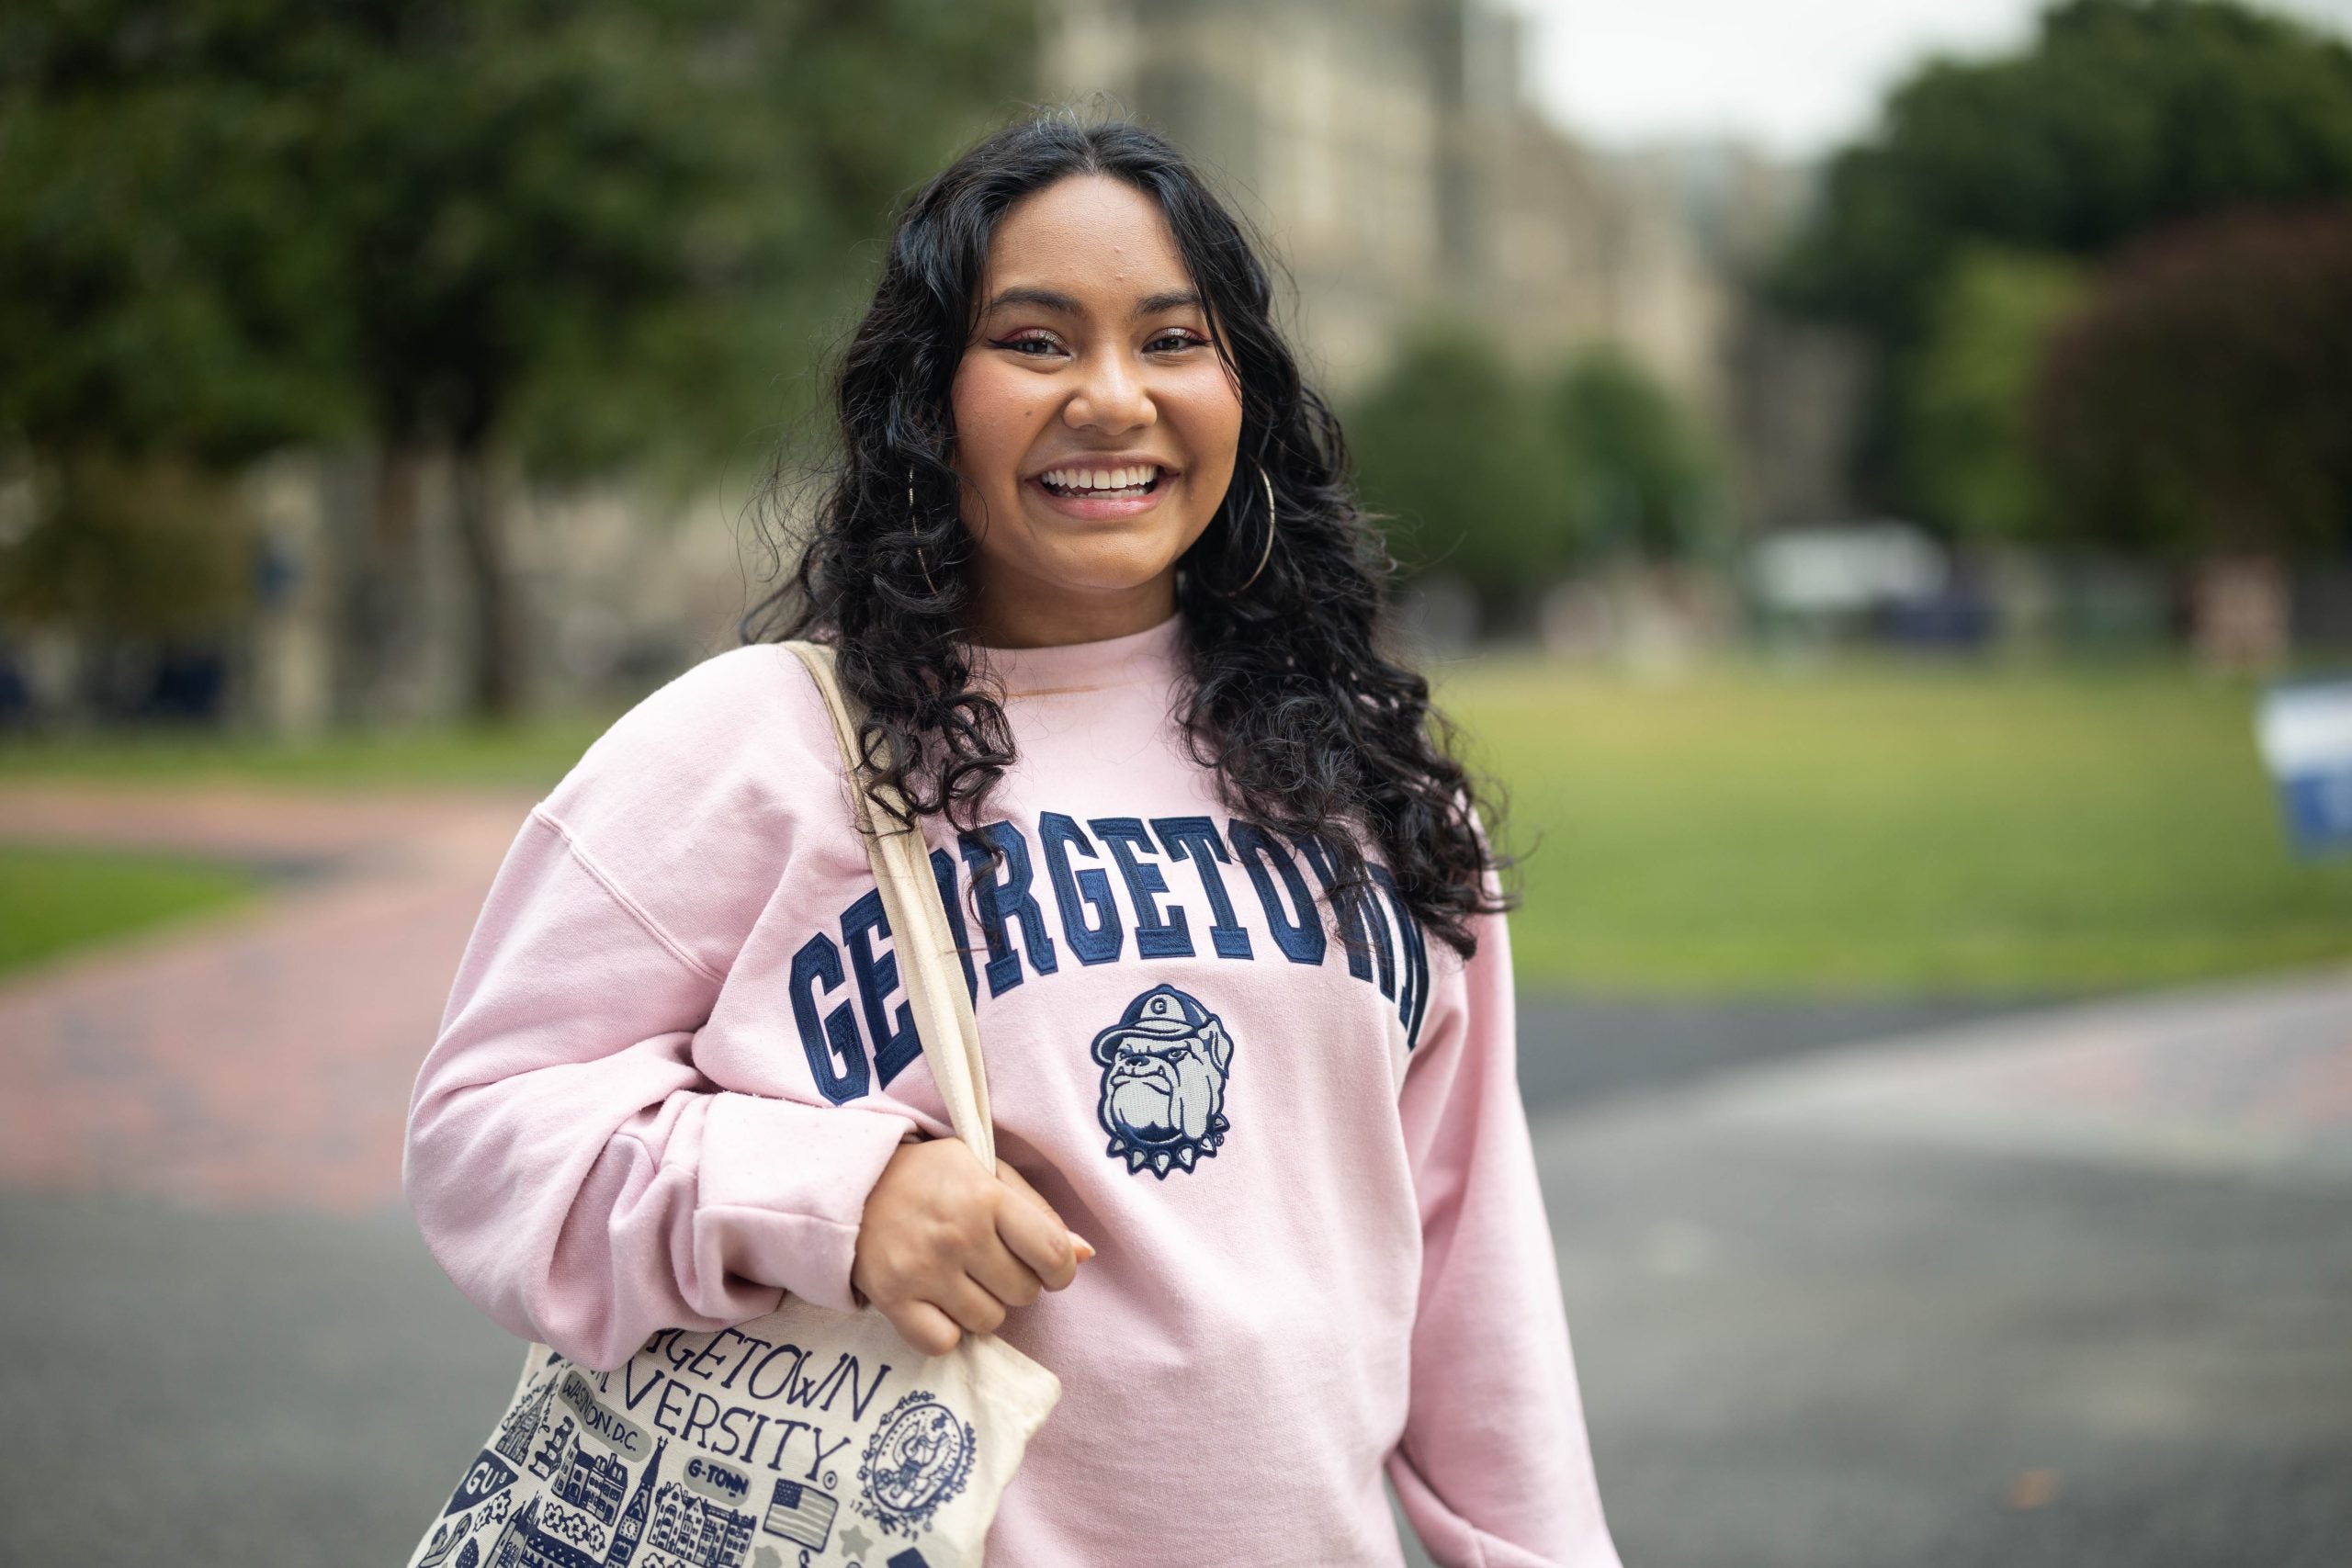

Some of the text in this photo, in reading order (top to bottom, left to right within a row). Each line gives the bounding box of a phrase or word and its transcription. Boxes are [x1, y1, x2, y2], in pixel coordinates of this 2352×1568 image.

[1150, 997, 1168, 1015] G
[646, 1326, 892, 1422] GETOWN
[592, 1356, 853, 1483] VERSITY
[466, 1461, 500, 1495] GU
[687, 1458, 750, 1497] G-TOWN
